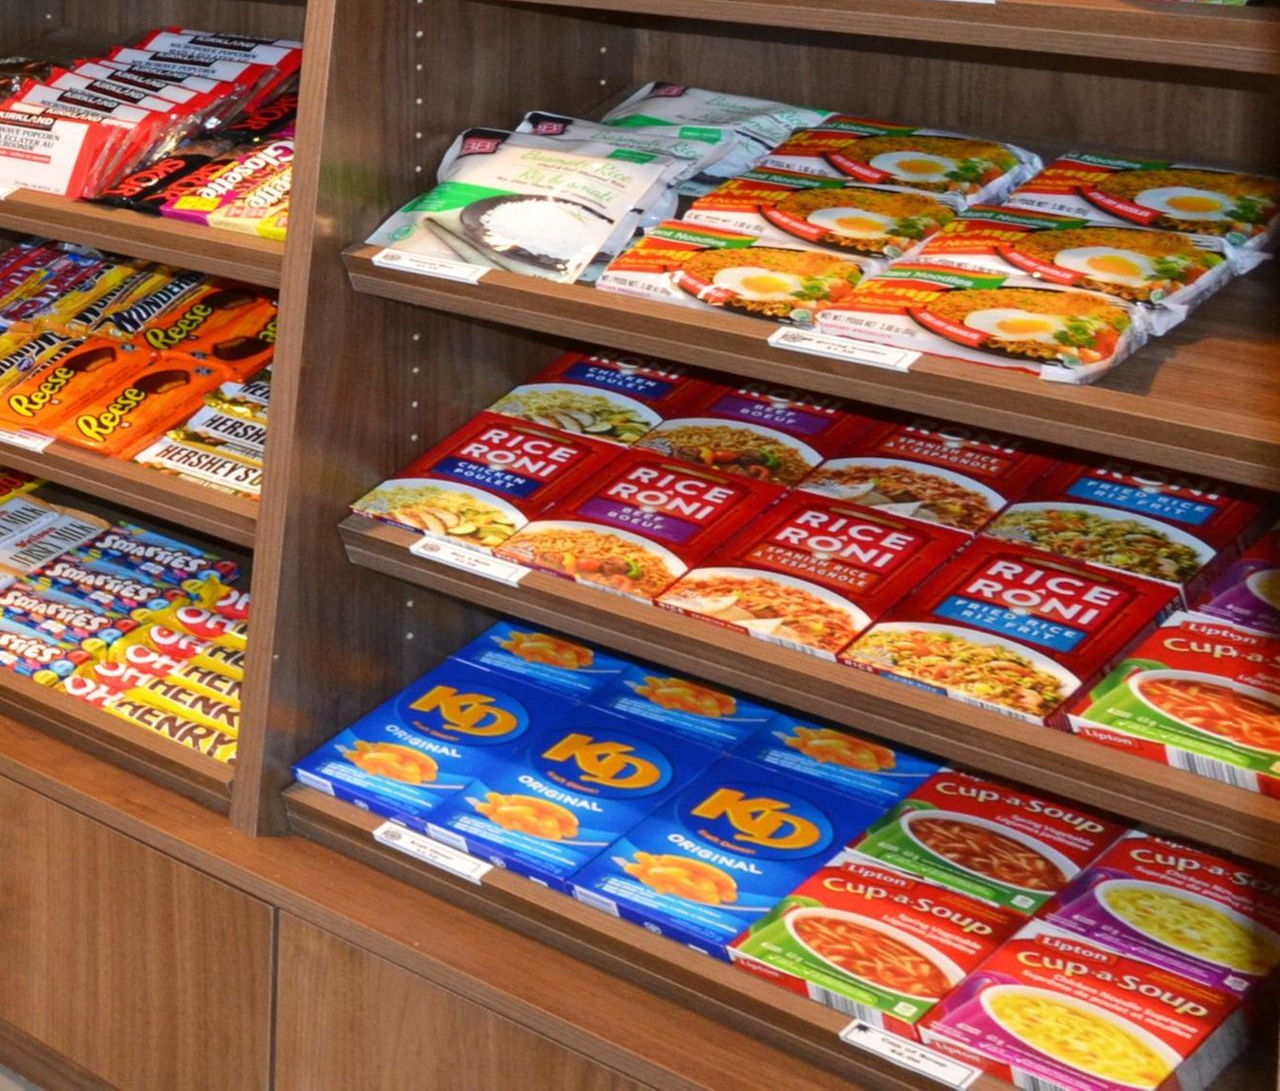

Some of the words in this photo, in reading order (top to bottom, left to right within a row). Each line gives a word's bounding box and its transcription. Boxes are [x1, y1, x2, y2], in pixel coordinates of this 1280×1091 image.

[145, 303, 212, 350] Reese
[9, 365, 75, 417] Reese
[588, 367, 657, 387] CHICKEN
[77, 387, 145, 443] Reese
[740, 409, 797, 425] BOEUF
[753, 403, 797, 418] BEEF
[480, 428, 578, 463] RICE
[452, 468, 515, 490] POULET
[458, 462, 526, 485] CHICKEN
[627, 468, 735, 504] RICE
[621, 506, 666, 522] BEEF
[1153, 493, 1207, 513] RICE
[607, 511, 670, 531] BOEUF
[794, 510, 915, 551] RICE
[765, 545, 828, 568] SPANISH
[831, 563, 869, 580] RICE
[985, 560, 1121, 608] RICE
[954, 598, 1019, 622] FRIED
[1021, 616, 1077, 640] RICE
[960, 608, 1000, 627] RIZ
[1004, 619, 1054, 642] FRIT
[1189, 623, 1258, 644] Lipton
[408, 685, 518, 737] KD
[384, 723, 463, 758] ORIGINAL
[1084, 728, 1133, 746] Lipton
[541, 733, 662, 789] KD
[518, 775, 604, 813] ORIGINAL
[691, 788, 821, 849] KD
[666, 833, 763, 875] ORIGINAL
[847, 863, 908, 889] Lipton
[1042, 936, 1108, 962] Lipton
